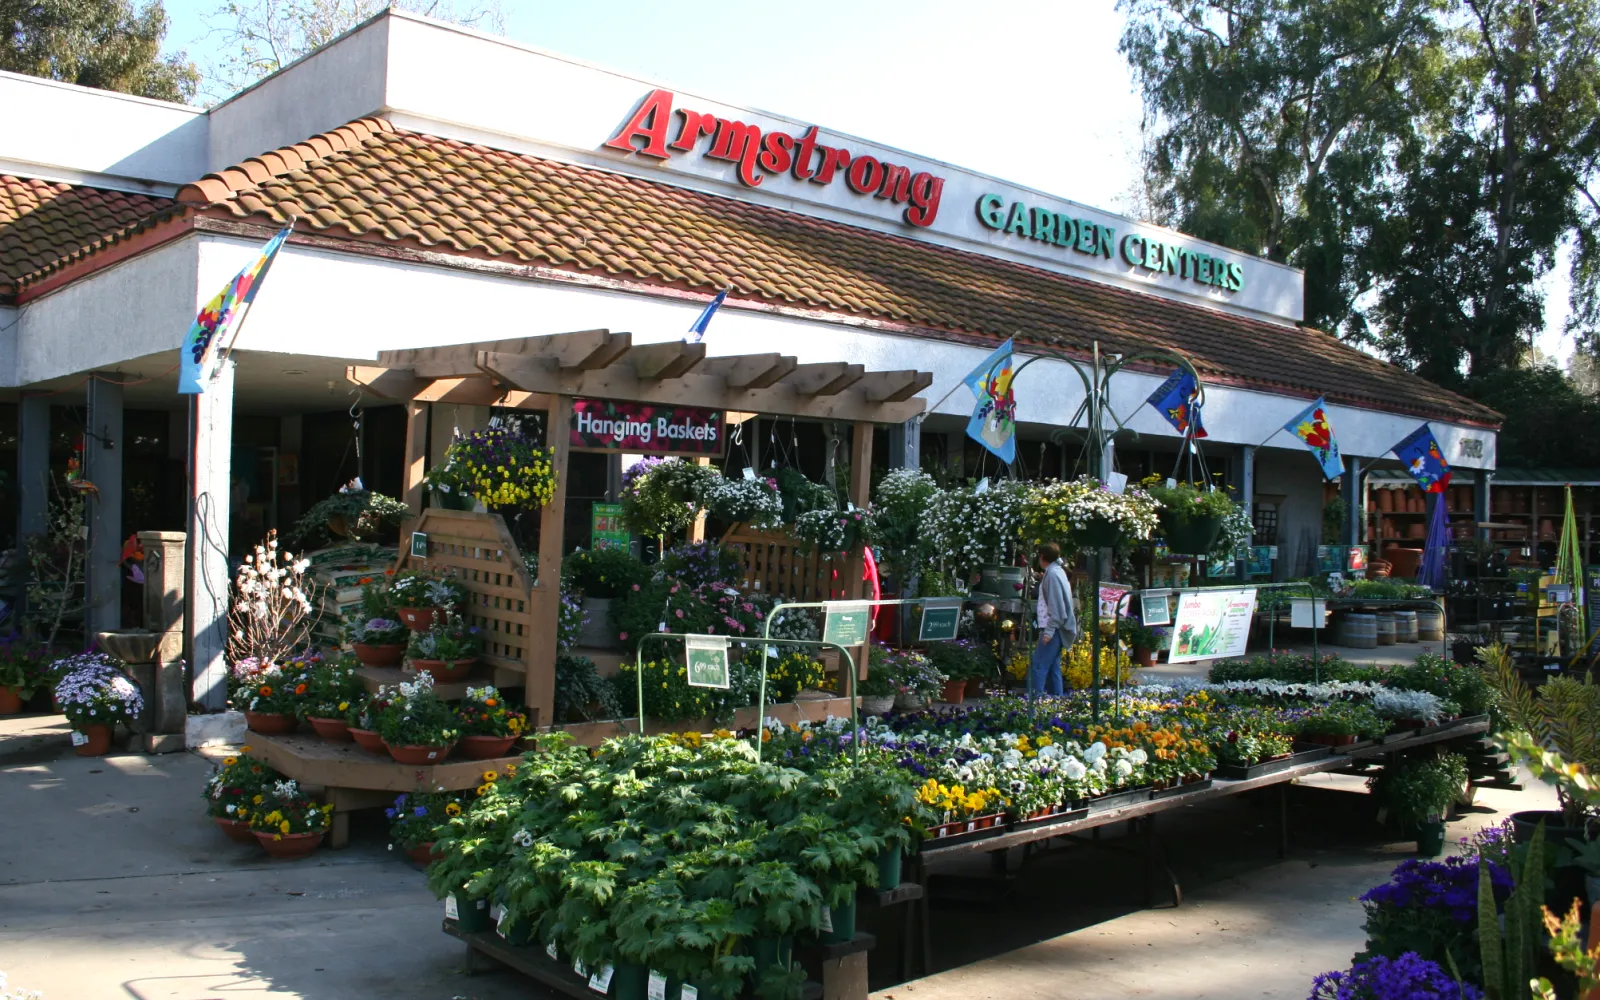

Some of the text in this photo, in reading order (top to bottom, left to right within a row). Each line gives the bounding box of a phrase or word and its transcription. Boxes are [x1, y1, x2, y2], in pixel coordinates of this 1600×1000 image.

[604, 88, 946, 227] Armstrong
[975, 193, 1245, 292] GARDEN CENTERS
[577, 411, 717, 443] Hanging Baskets
